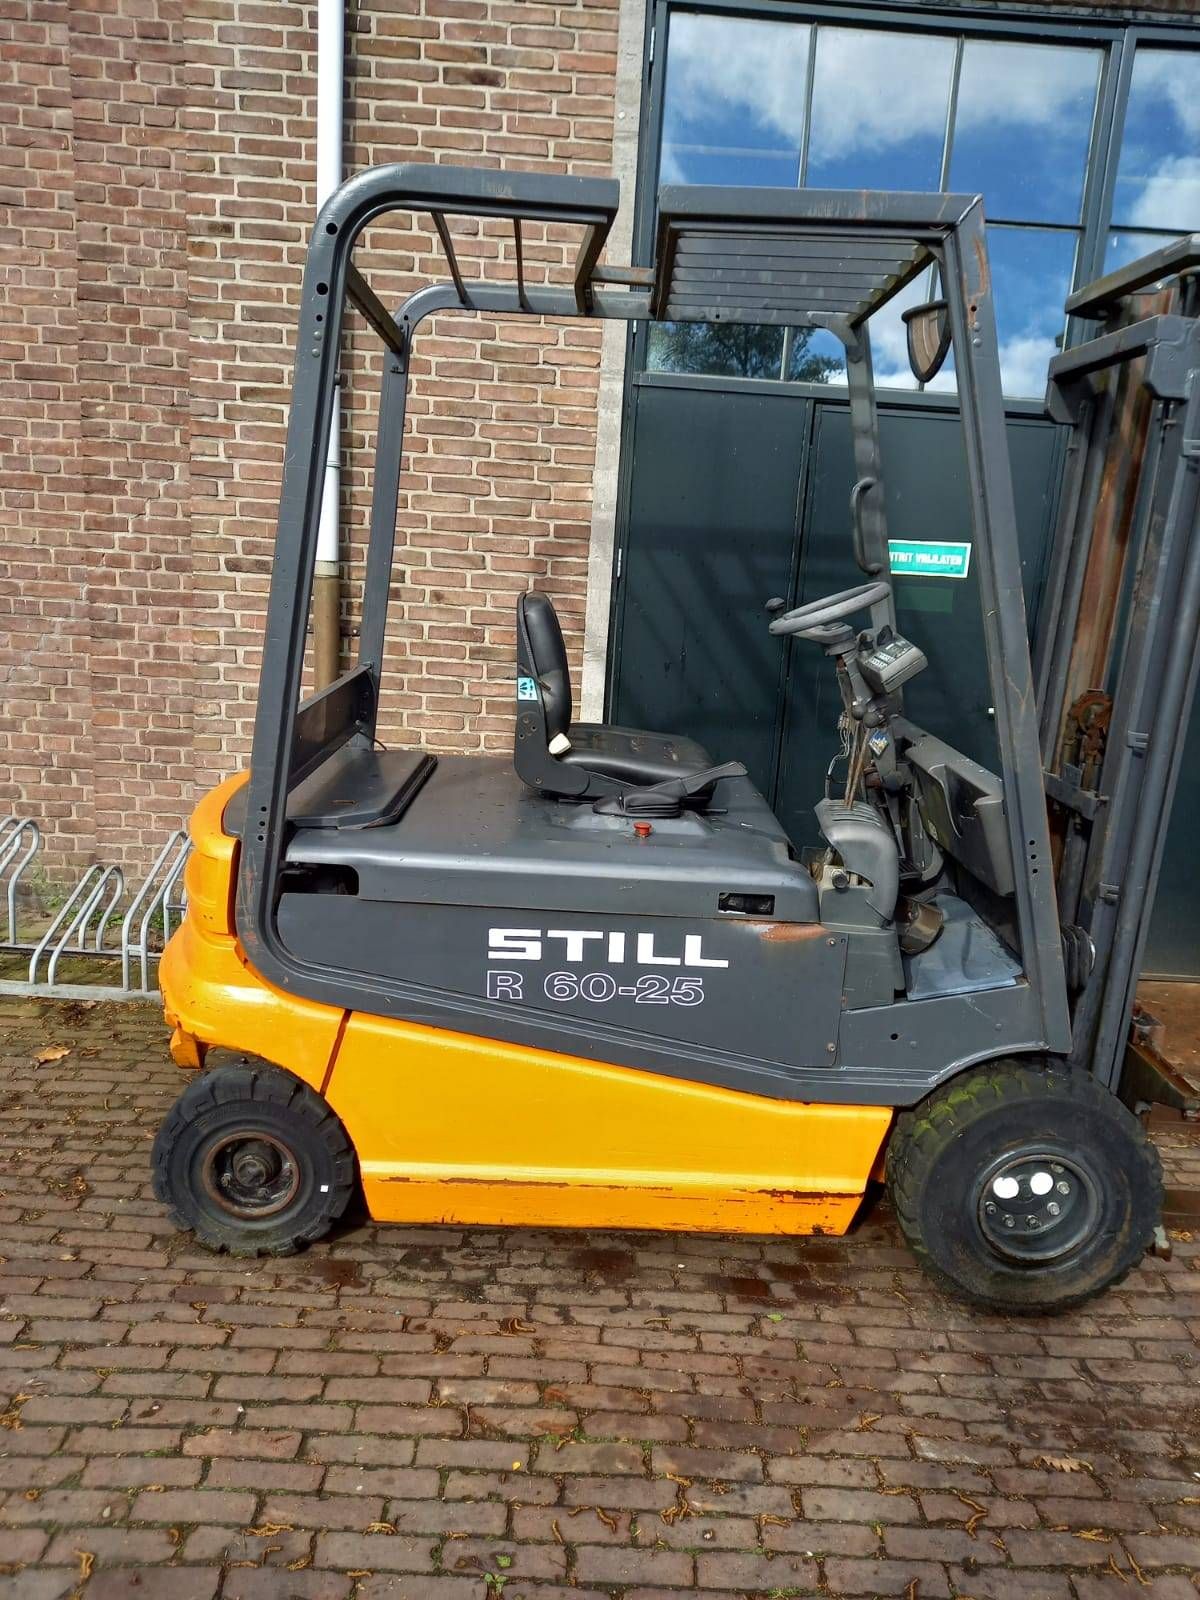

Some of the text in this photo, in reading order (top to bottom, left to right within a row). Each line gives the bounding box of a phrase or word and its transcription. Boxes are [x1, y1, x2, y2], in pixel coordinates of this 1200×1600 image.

[487, 928, 729, 968] STILL
[487, 970, 705, 1006] R 60-25
